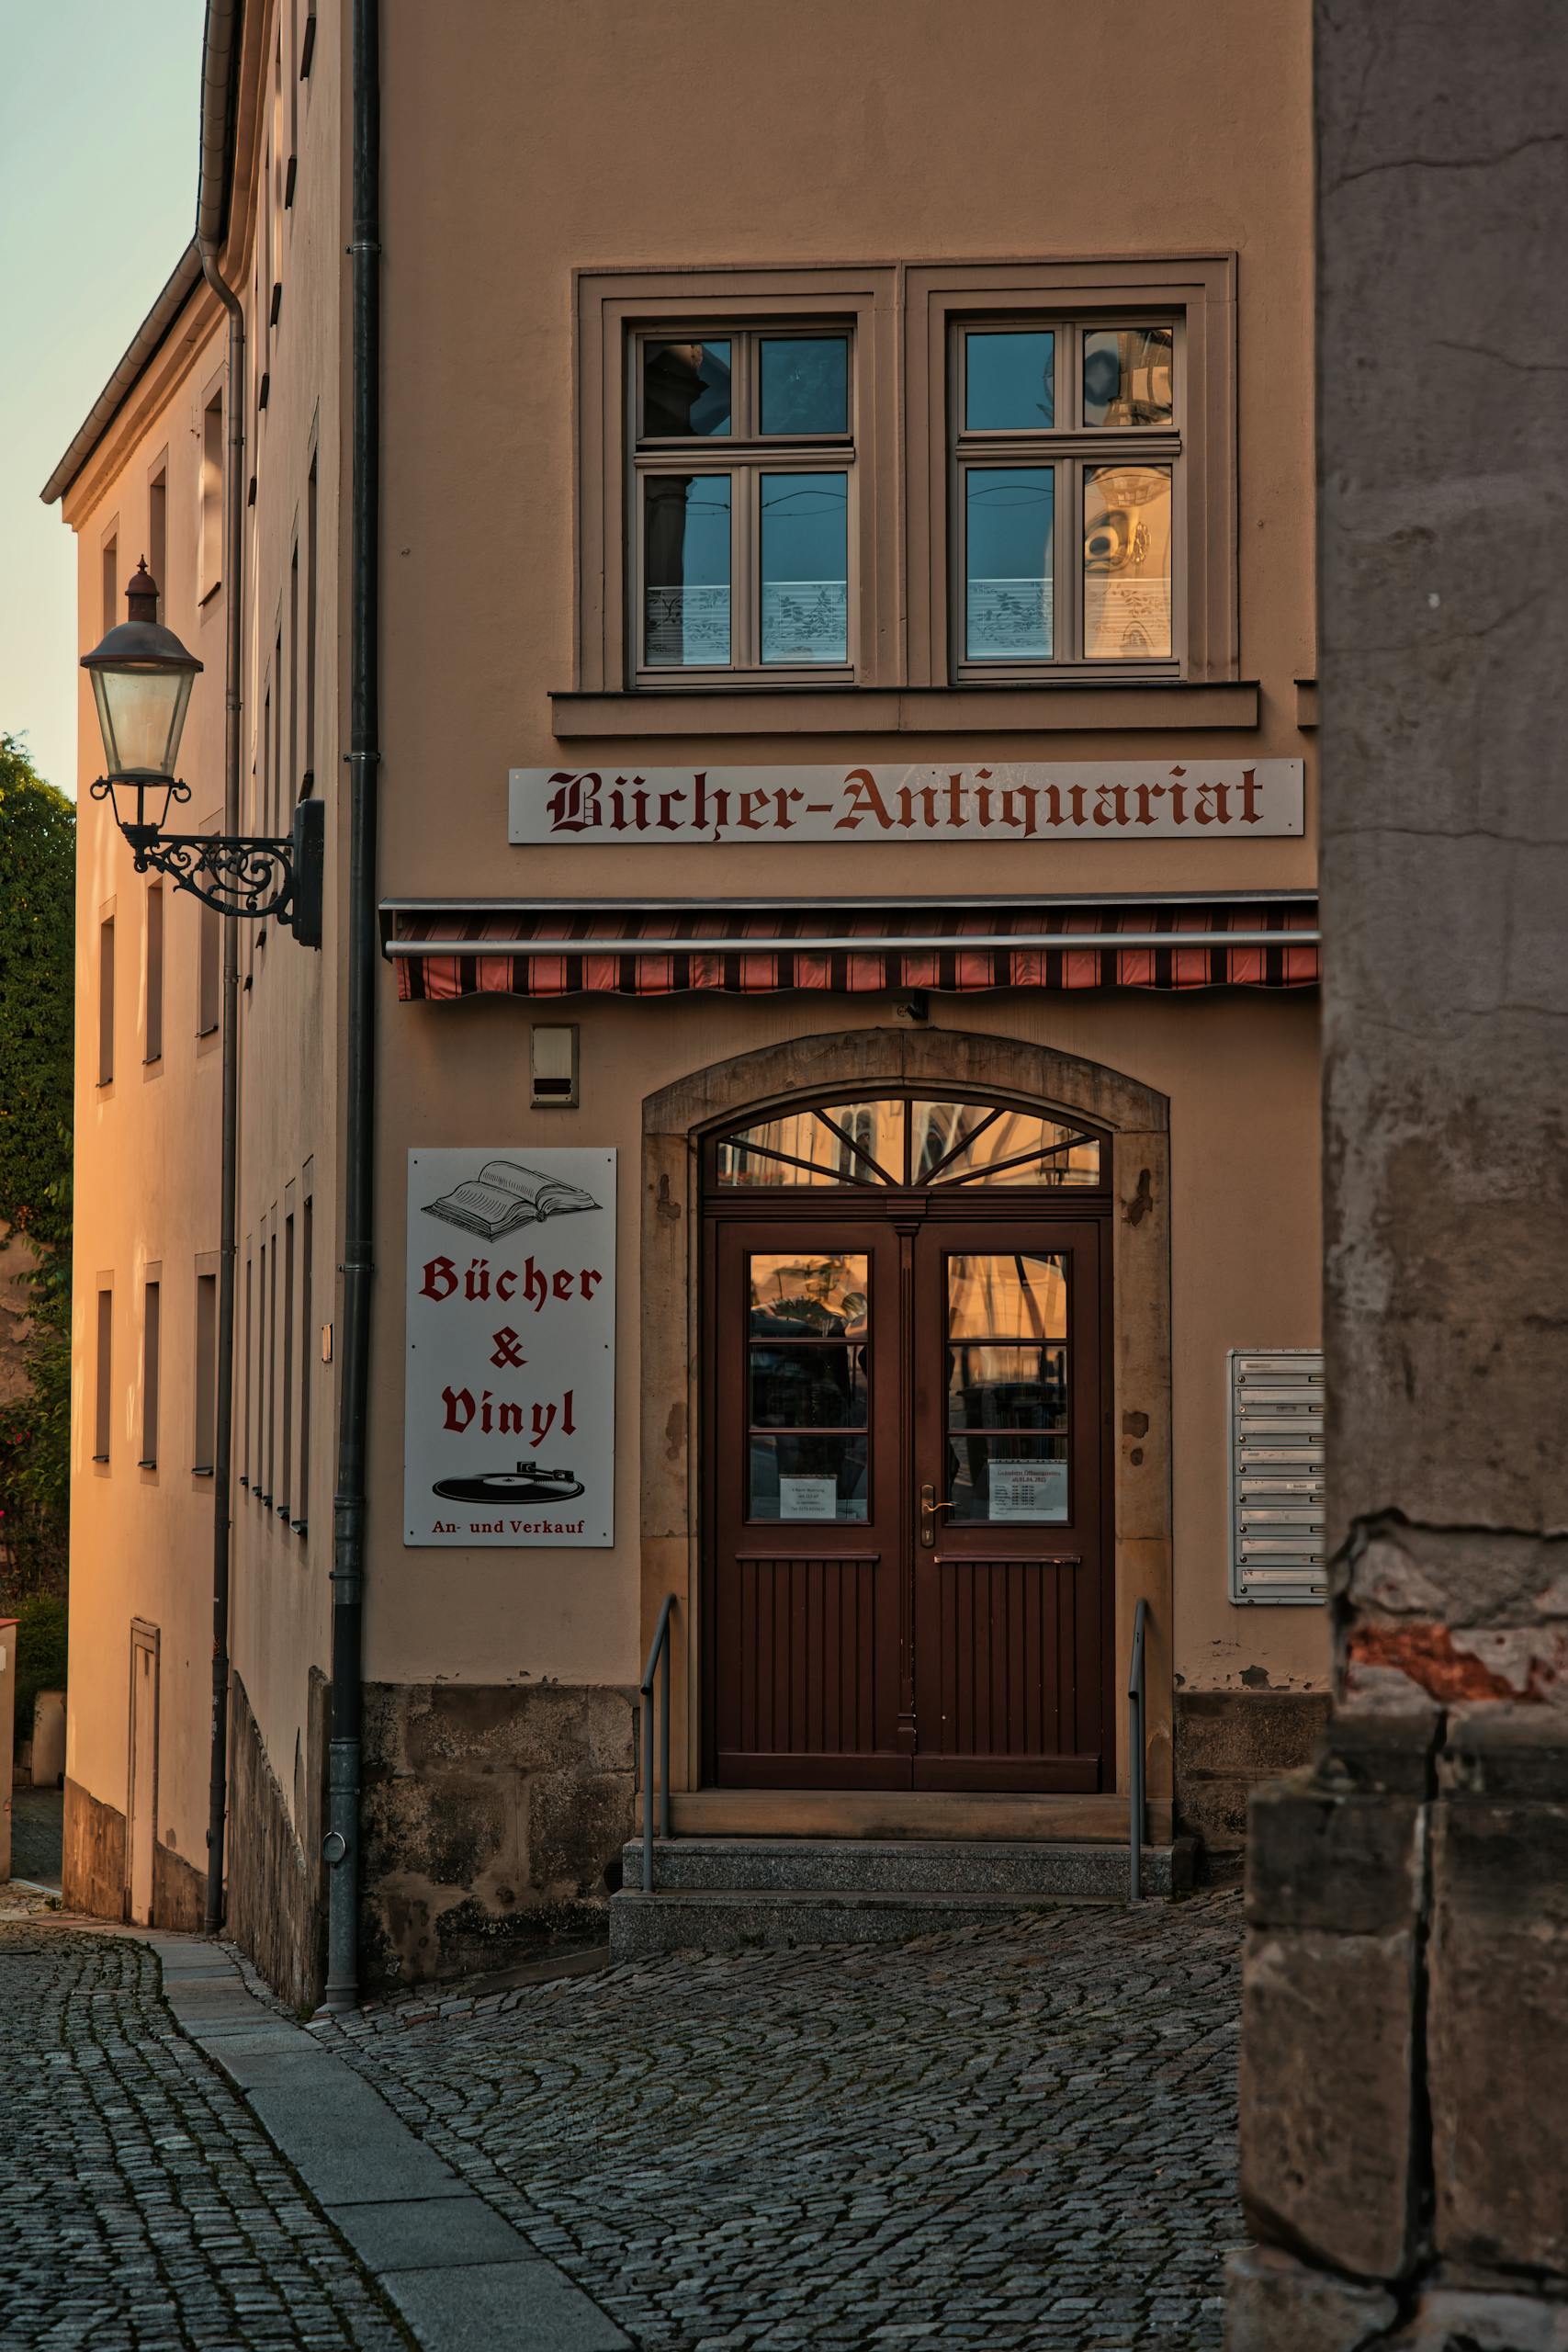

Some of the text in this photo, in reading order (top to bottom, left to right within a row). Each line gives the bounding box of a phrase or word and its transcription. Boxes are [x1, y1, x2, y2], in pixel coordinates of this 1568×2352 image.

[547, 765, 1264, 842] Bücher-Antiquariat
[418, 1255, 603, 1313] Bücher
[490, 1326, 529, 1369] &
[442, 1386, 577, 1448] Vinyl
[432, 1520, 585, 1533] An- und Verkauf
